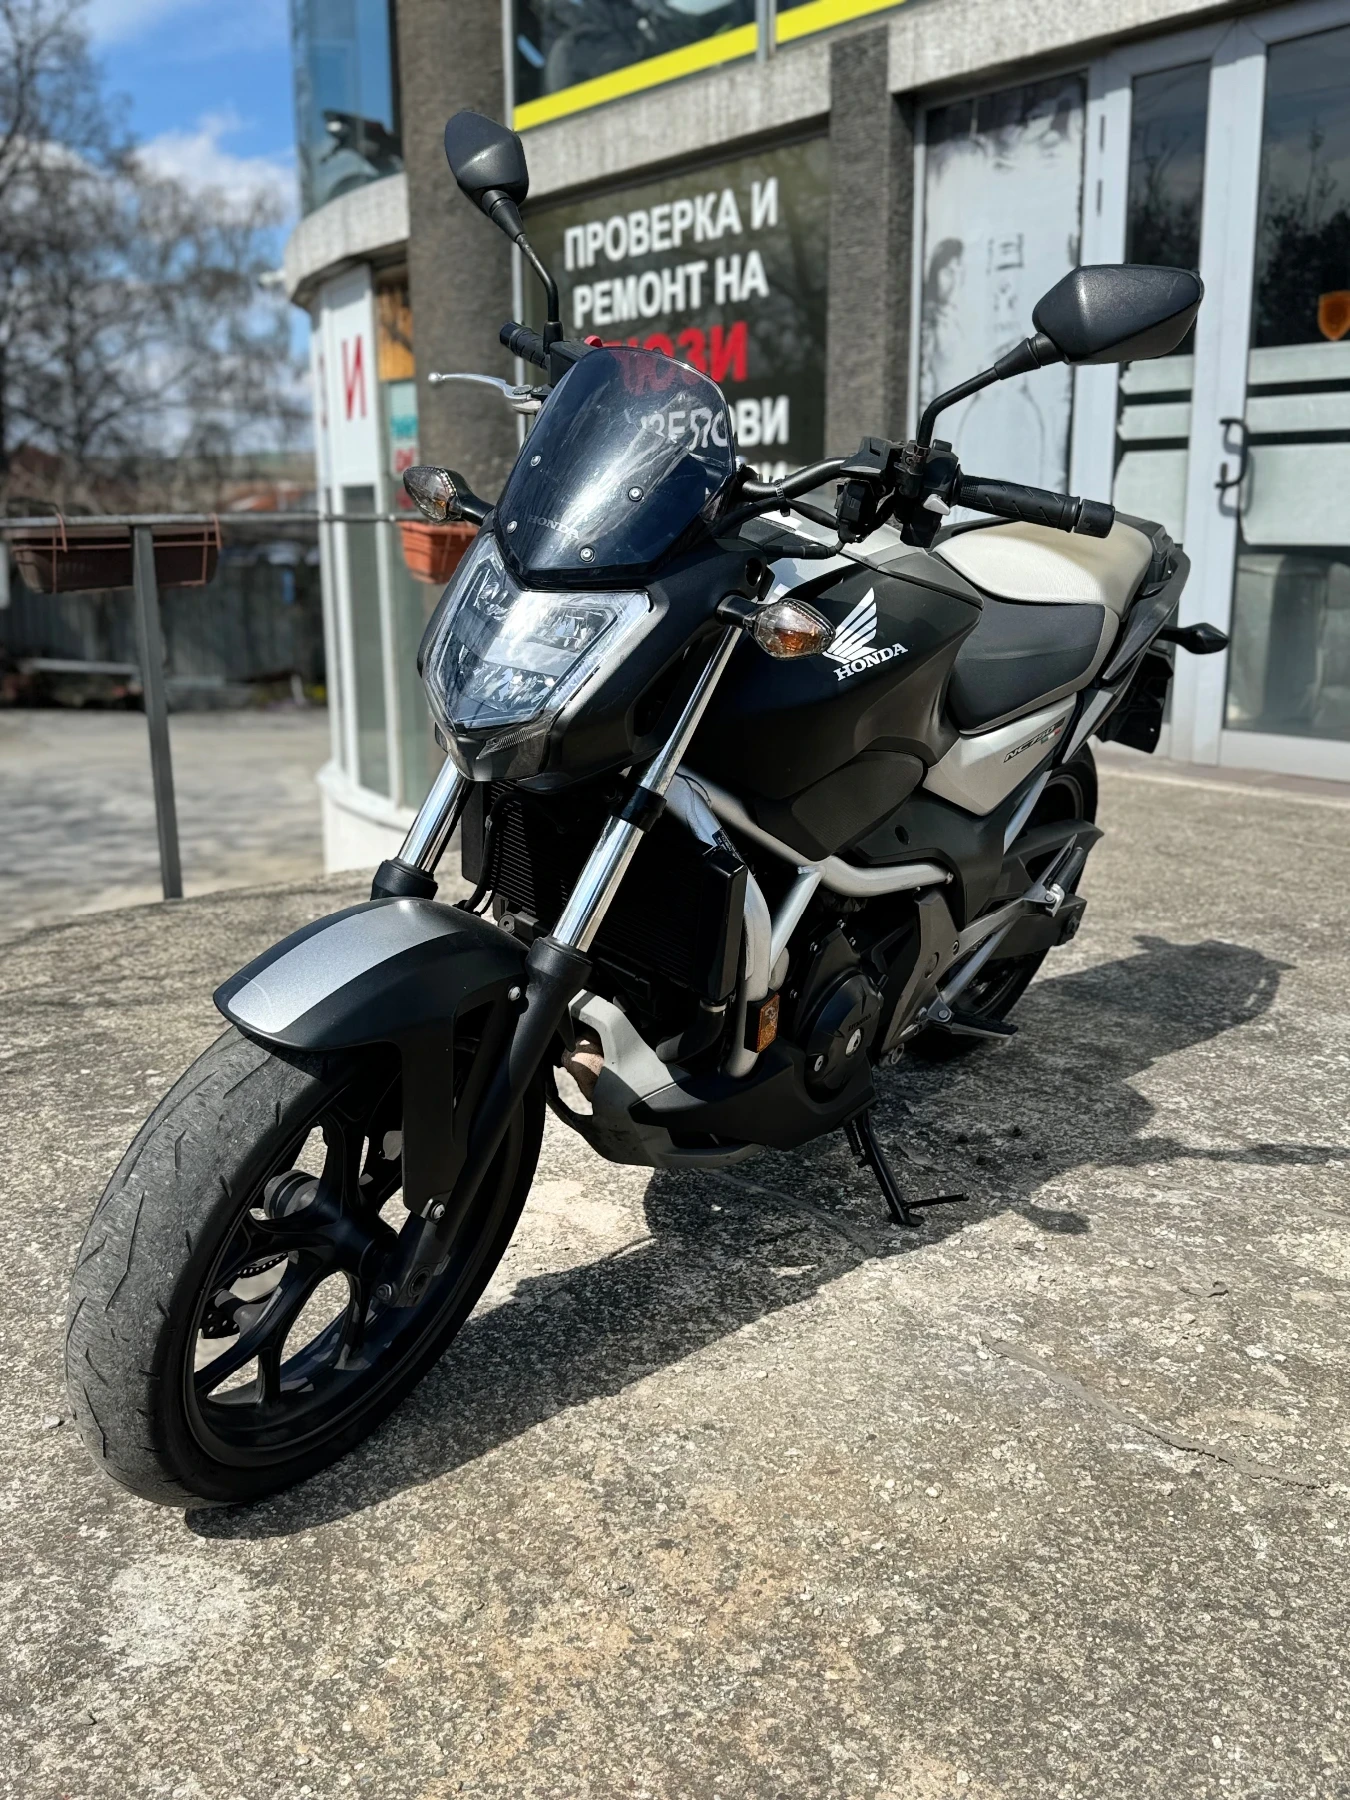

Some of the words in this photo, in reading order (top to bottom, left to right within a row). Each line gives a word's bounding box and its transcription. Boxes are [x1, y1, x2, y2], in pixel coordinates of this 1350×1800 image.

[564, 188, 743, 272] ПРОВЕРКА
[750, 176, 779, 231] И
[572, 260, 708, 329] РЕМОНТ
[714, 250, 770, 306] НА
[602, 321, 749, 396] ЮЗИ
[527, 513, 580, 540] HONDA
[833, 642, 909, 682] HONDA
